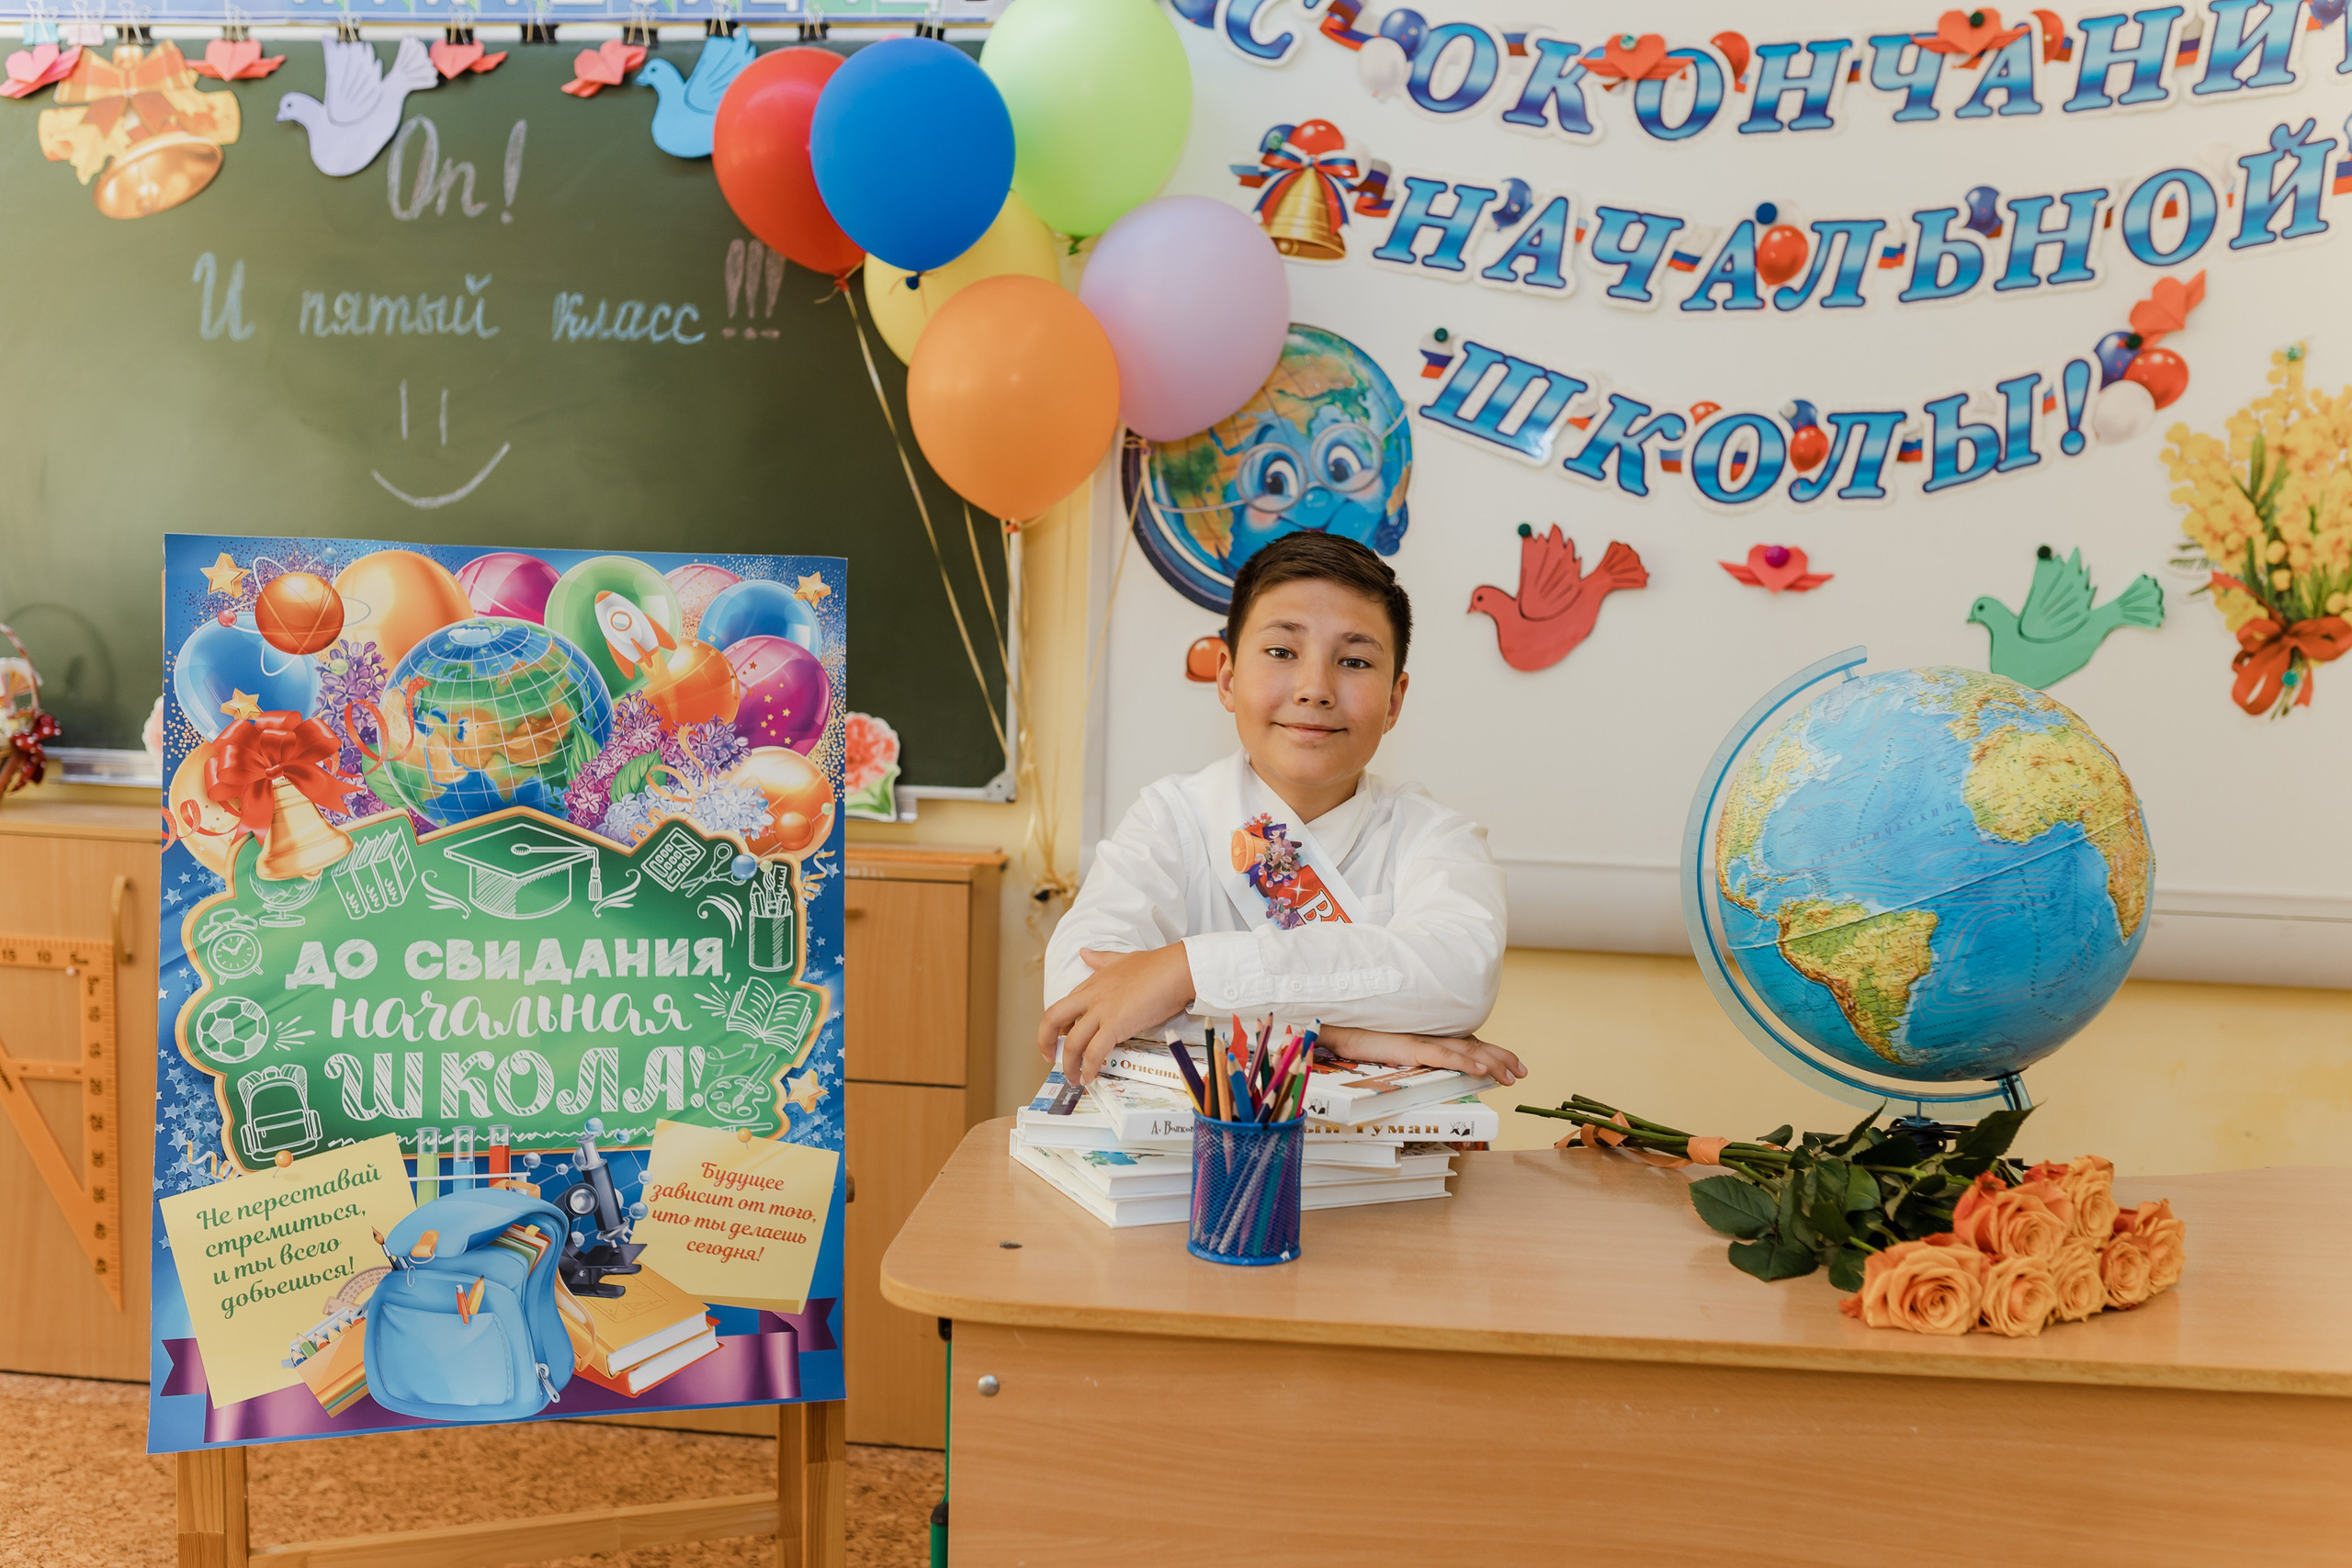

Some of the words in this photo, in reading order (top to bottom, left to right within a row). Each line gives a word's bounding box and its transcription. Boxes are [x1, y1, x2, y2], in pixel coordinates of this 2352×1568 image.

[1407, 0, 2352, 141] ОКОНЧАНИ
[1373, 118, 2338, 312] НАЧАЛЬНОЙ
[194, 252, 255, 340] И
[300, 274, 500, 338] пятый
[1419, 340, 2092, 504] ШКОЛЫ!
[285, 938, 378, 989] ДО
[405, 937, 731, 985] СВИДАНИЯ,
[331, 990, 692, 1042] начальная
[324, 1045, 706, 1122] ШКОЛА!
[196, 1207, 233, 1230] Не
[237, 1164, 382, 1221] переставай
[649, 1182, 734, 1208] зависит
[738, 1198, 765, 1213] от
[768, 1203, 818, 1224] того,
[701, 1162, 786, 1191] Будущее
[205, 1202, 368, 1258] стремиться,
[651, 1208, 691, 1226] что
[694, 1216, 728, 1232] ты
[728, 1222, 808, 1244] делаешь
[685, 1240, 765, 1264] сегодня!
[212, 1270, 231, 1286] и
[233, 1258, 277, 1279] ты
[279, 1237, 343, 1266] всего
[220, 1256, 356, 1320] добьешься!
